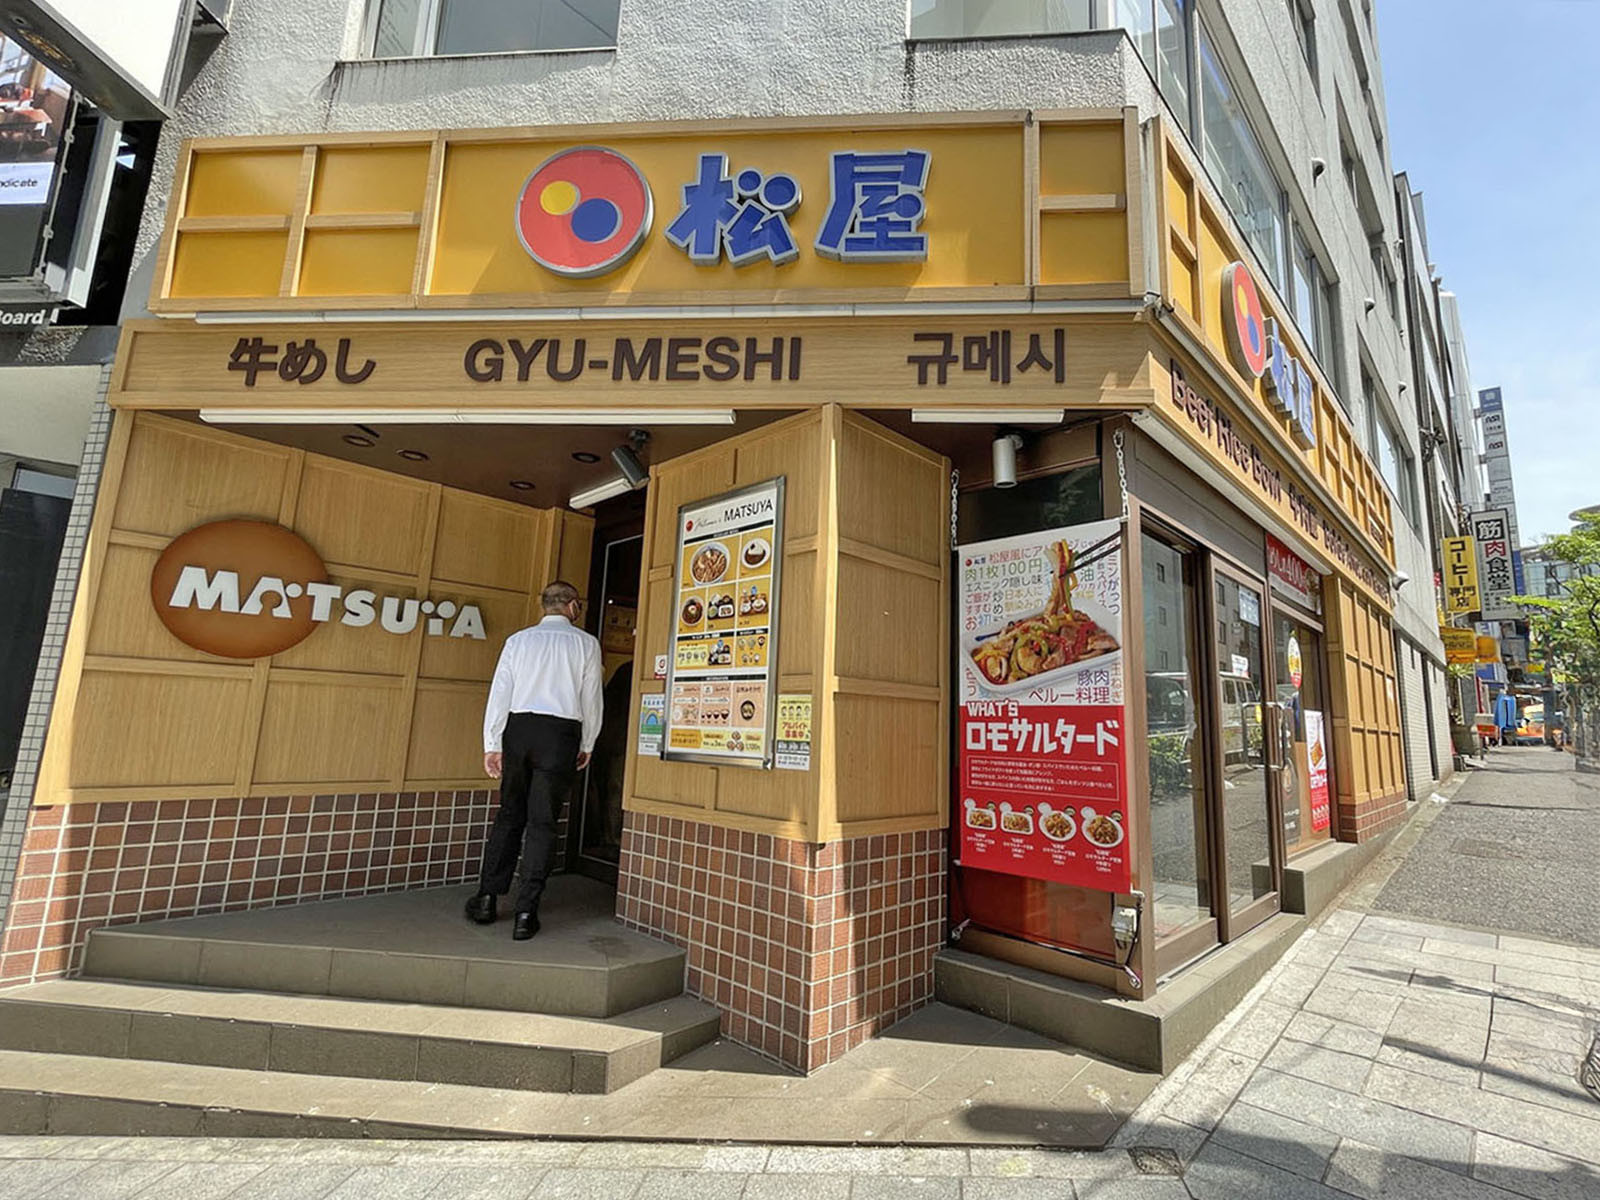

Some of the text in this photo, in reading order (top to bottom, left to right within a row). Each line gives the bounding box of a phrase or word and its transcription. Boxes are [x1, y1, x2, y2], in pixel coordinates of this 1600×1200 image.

[664, 150, 932, 268] 松屋
[228, 337, 376, 387] 牛めし
[464, 336, 802, 382] GYU-MESHI
[907, 328, 1065, 385] 규메시
[1170, 359, 1213, 440] Beef
[724, 498, 773, 523] MATSUYA
[965, 558, 1042, 583] 肉1枚100円
[1478, 520, 1511, 591] 筋肉食堂
[168, 566, 487, 640] MATSUYA
[965, 574, 1043, 593] エスニック隠し味
[1029, 687, 1110, 704] ペルー料理
[1077, 669, 1110, 687] 豚肉
[966, 699, 1019, 717] WHAT'S
[966, 718, 1119, 756] ロモサルタード
